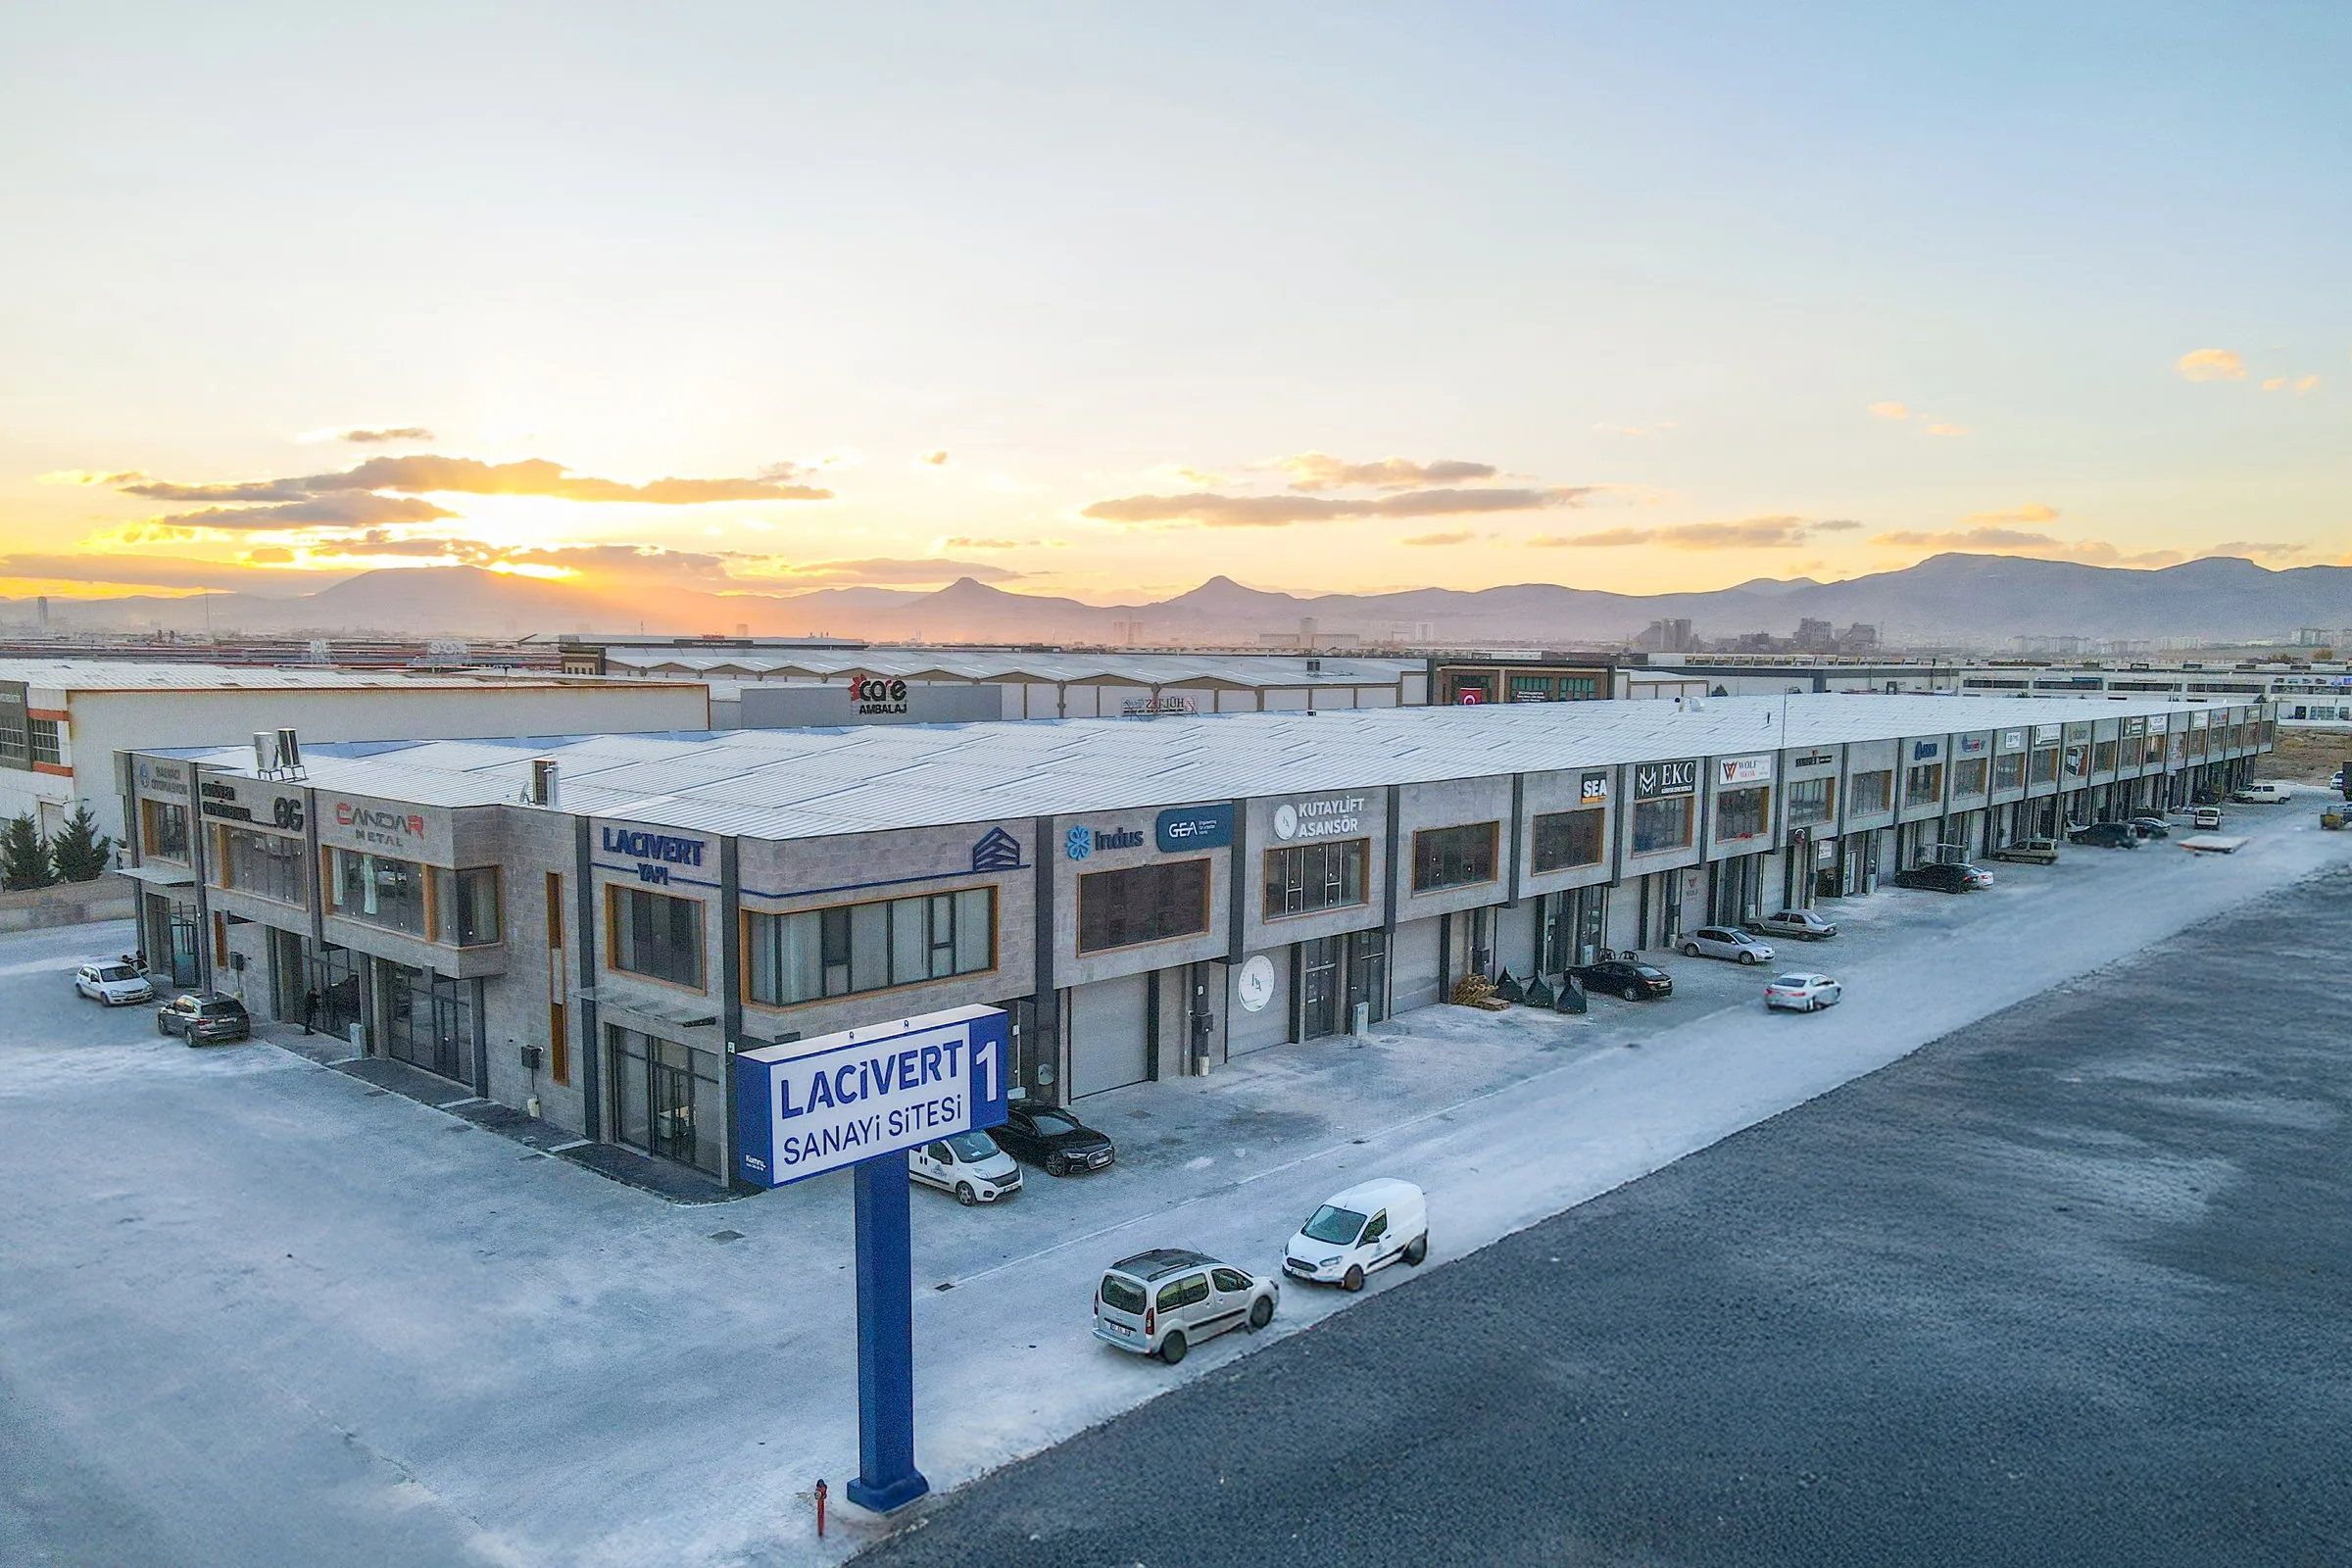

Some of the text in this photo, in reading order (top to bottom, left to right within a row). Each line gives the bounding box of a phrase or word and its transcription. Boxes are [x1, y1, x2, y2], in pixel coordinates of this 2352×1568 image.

[859, 704, 907, 714] AMBALAJ
[1661, 761, 1694, 786] EKC
[1739, 760, 1758, 769] WOLF
[1583, 779, 1607, 798] SEA
[1298, 795, 1365, 818] KUTAYLİFT
[336, 802, 424, 841] CANDAR
[1169, 821, 1198, 838] GEA
[1298, 814, 1358, 838] ASANSÖR
[356, 829, 404, 848] METAL
[1095, 827, 1145, 852] Indus
[637, 862, 668, 886] YAPI
[975, 1040, 999, 1102] 1
